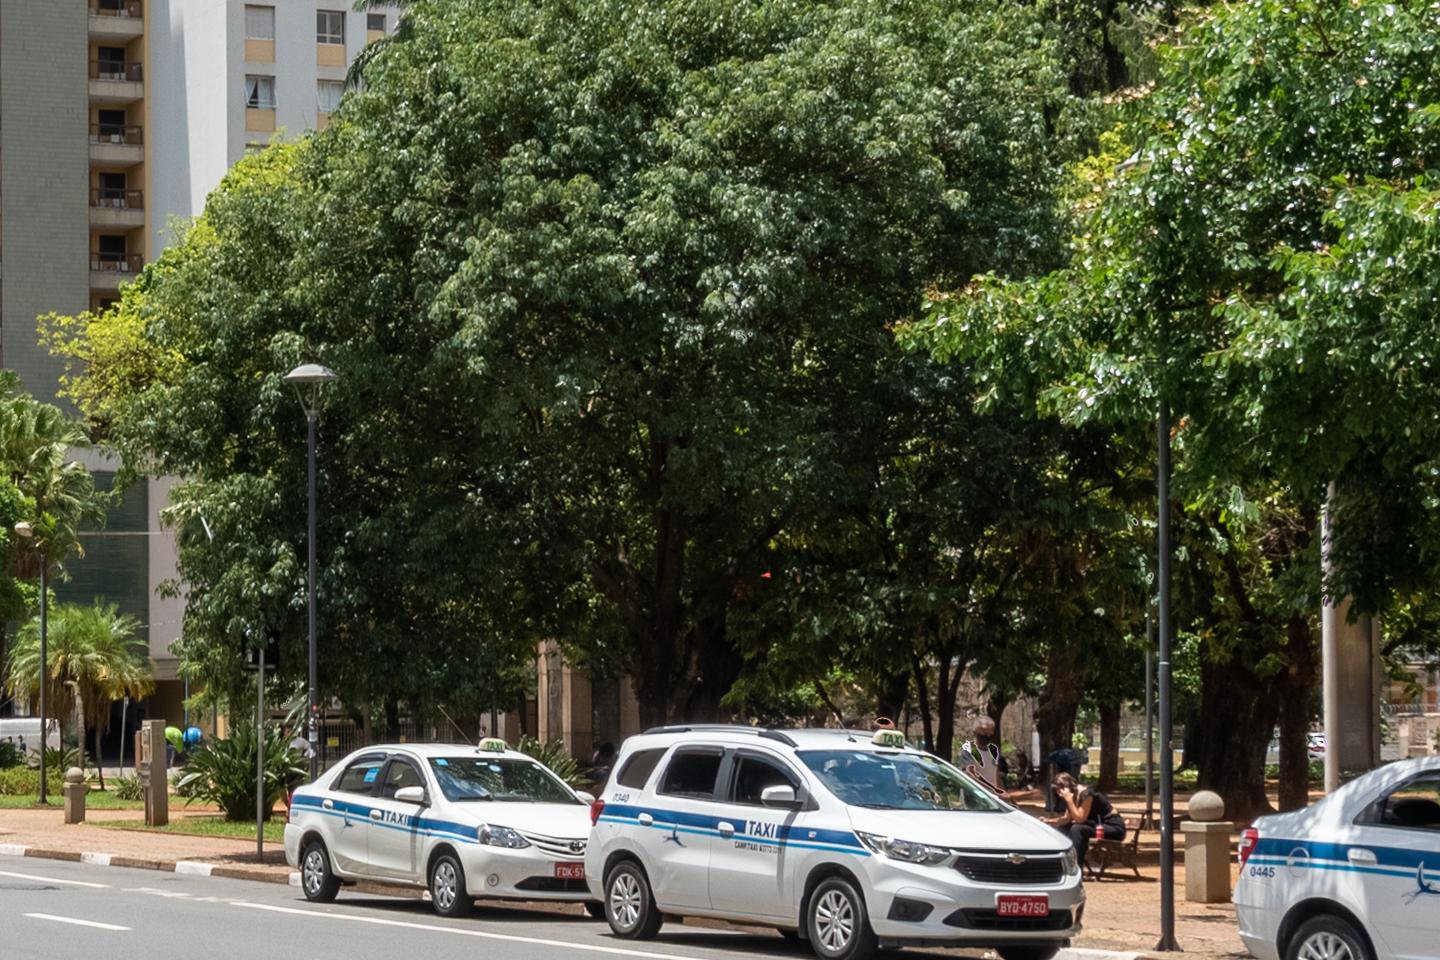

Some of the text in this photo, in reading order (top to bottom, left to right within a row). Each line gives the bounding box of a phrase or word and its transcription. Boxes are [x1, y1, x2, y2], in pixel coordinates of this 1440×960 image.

[882, 732, 903, 746] TAXI
[485, 740, 503, 751] TAXI
[612, 792, 630, 803] 0340
[384, 810, 408, 825] TAXI
[749, 821, 775, 838] TAXI
[1250, 866, 1275, 878] 0445
[1000, 902, 1046, 914] BYD-4750
